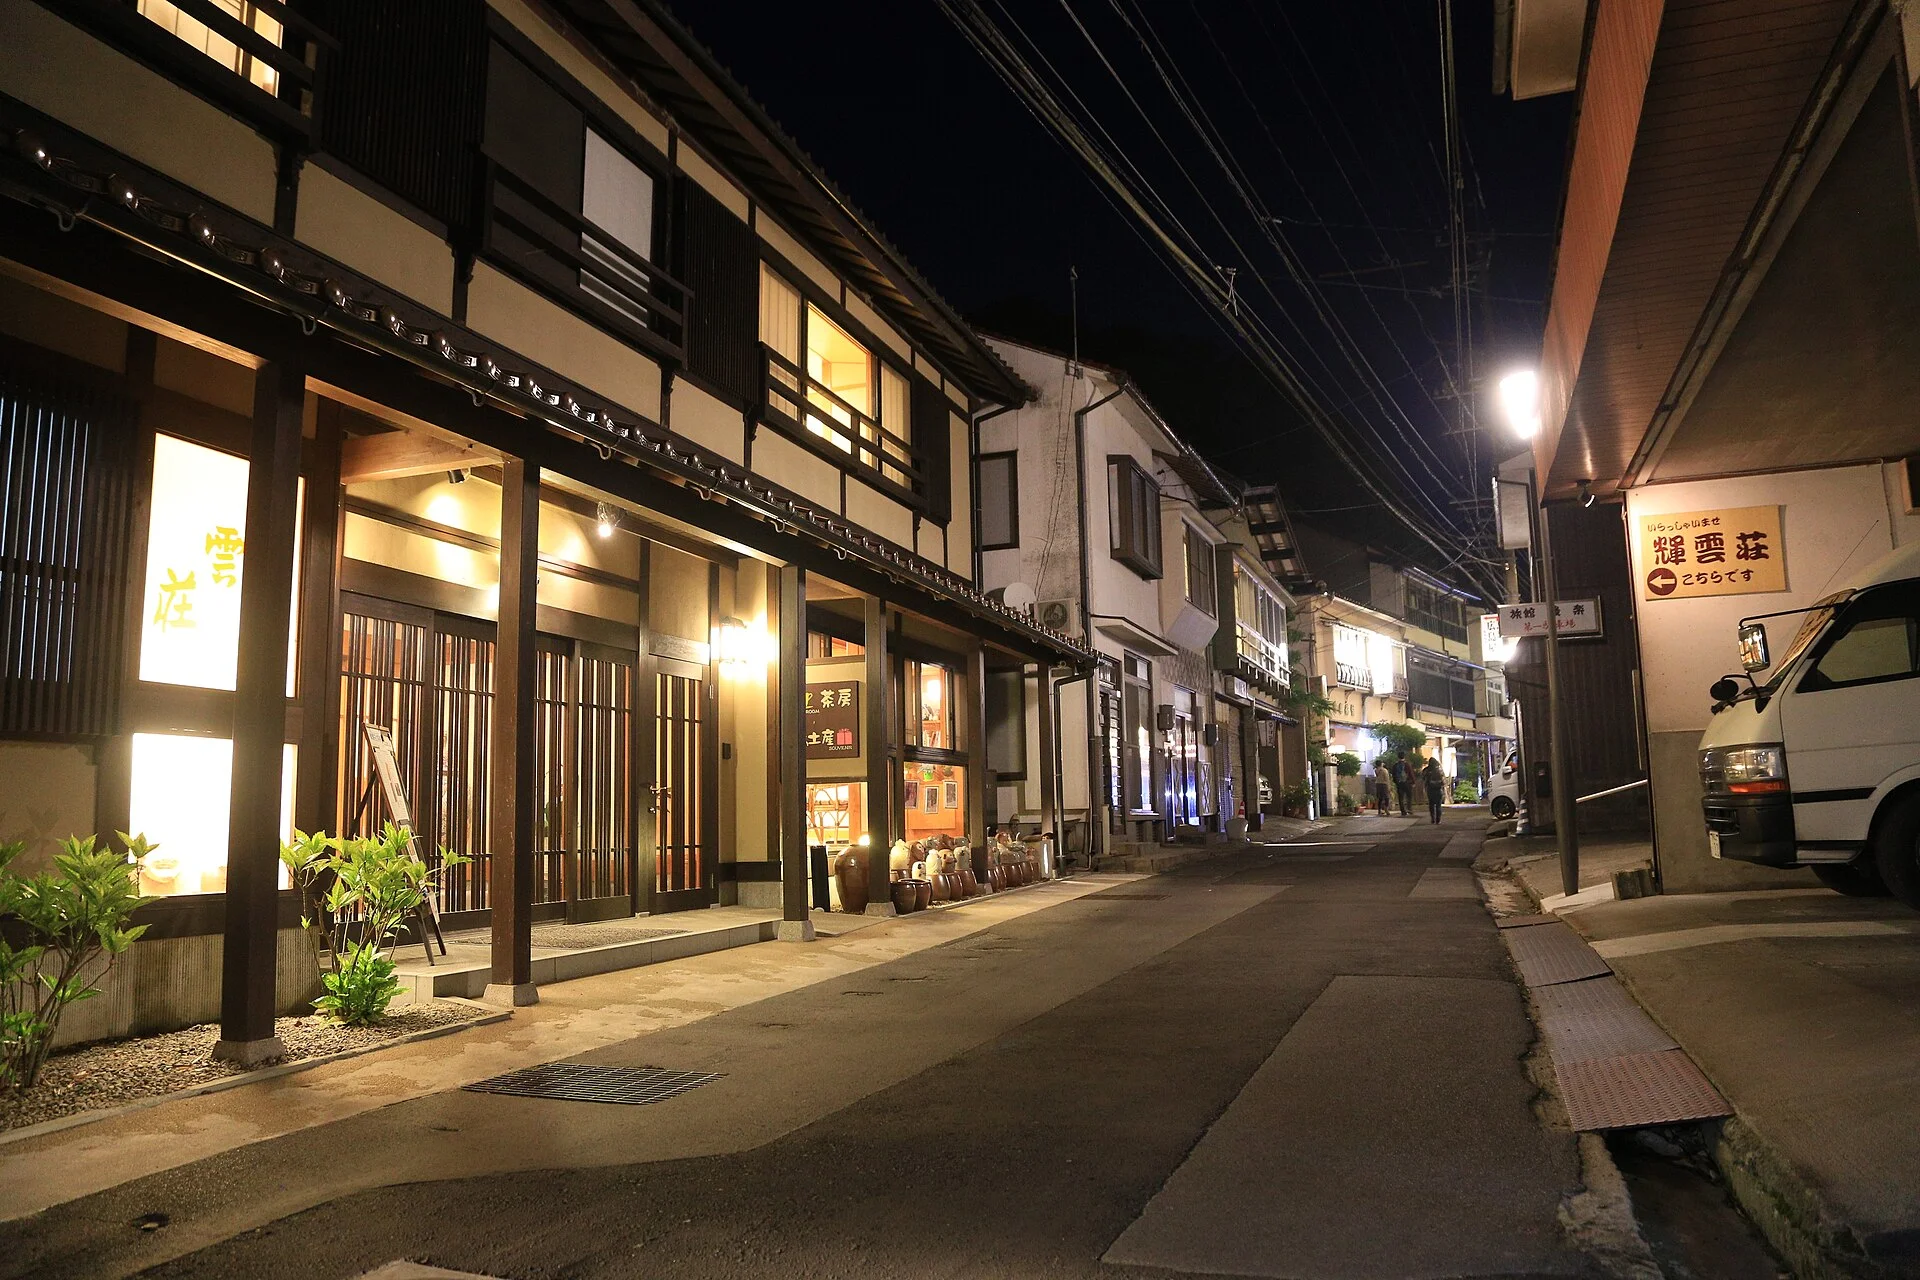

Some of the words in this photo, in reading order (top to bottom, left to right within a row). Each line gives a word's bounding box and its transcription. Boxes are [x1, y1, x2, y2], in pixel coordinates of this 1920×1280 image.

[1647, 516, 1721, 533] いらっしゃいませ
[1653, 530, 1770, 566] 輝雲荘
[1682, 568, 1754, 586] こちらです
[1510, 607, 1536, 619] 旅館
[821, 689, 851, 708] 茶房
[806, 729, 834, 746] 土産
